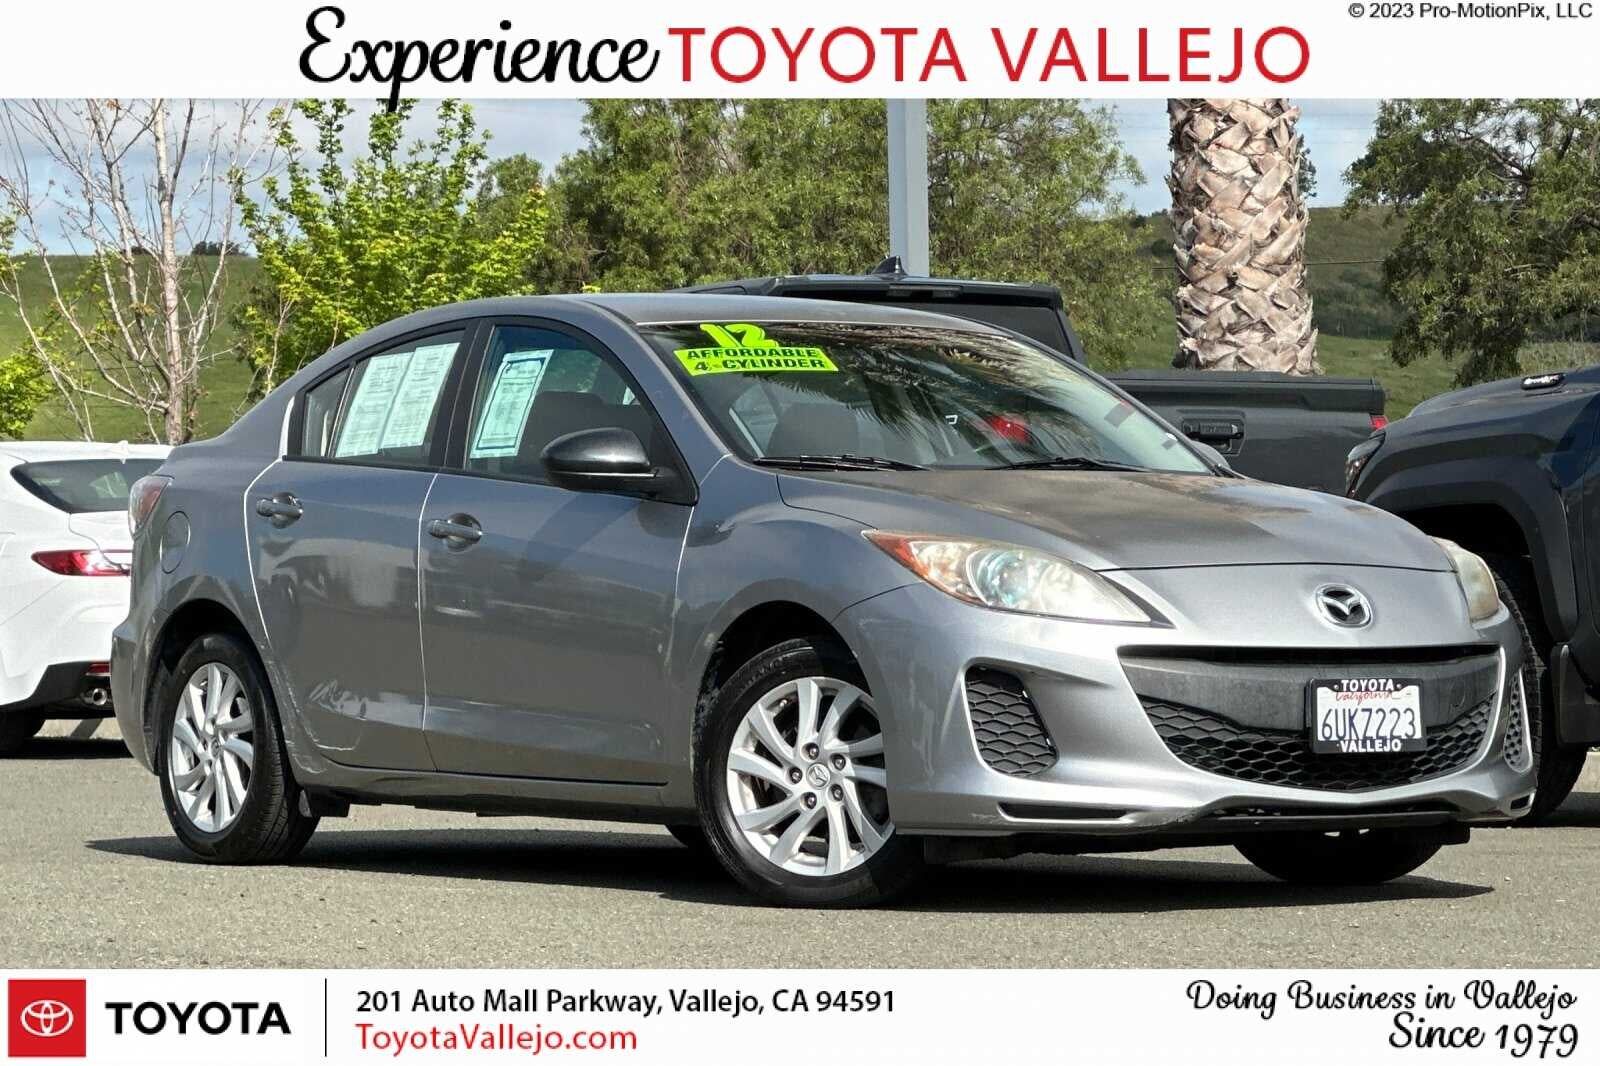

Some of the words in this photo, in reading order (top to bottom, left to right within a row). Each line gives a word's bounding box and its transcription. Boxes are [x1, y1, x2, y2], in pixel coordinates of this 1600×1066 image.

[700, 323, 779, 348] 12
[687, 348, 818, 360] AFFORDABLE
[1341, 679, 1395, 691] TOYOTA
[1321, 707, 1416, 740] 6UKZ223
[1340, 739, 1402, 752] VALLEJO
